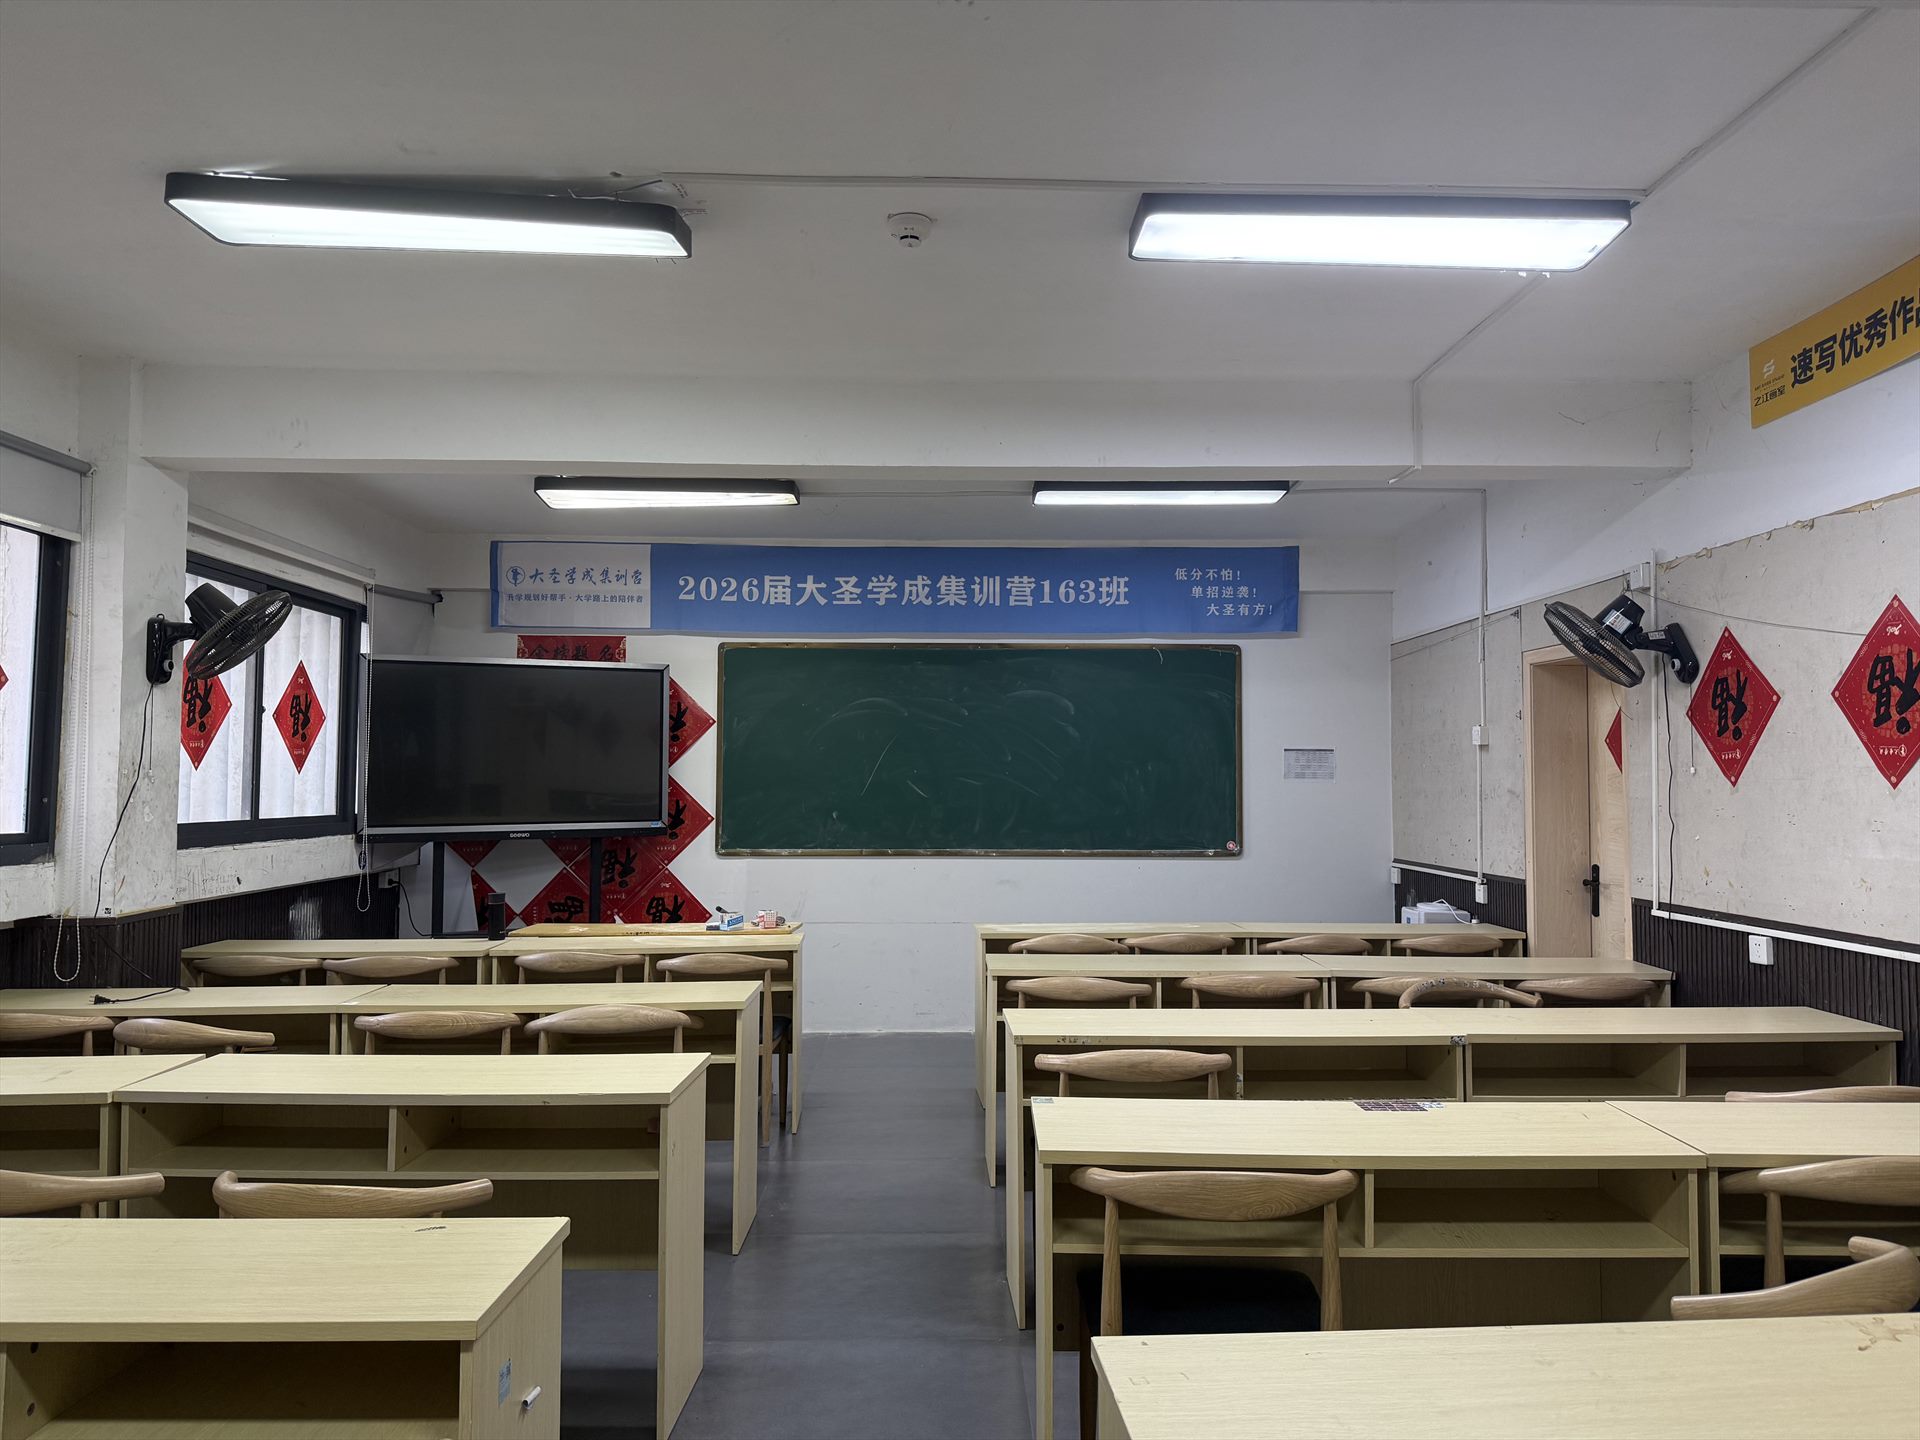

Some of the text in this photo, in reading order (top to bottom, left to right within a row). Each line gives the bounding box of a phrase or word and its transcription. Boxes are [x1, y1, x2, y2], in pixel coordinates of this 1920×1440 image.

[529, 567, 642, 585] 大圣学成集训营
[678, 575, 1130, 607] 2026届大圣学成集训营163班
[1711, 669, 1748, 740] 福
[1867, 648, 1920, 735] 福
[289, 693, 311, 742] 福
